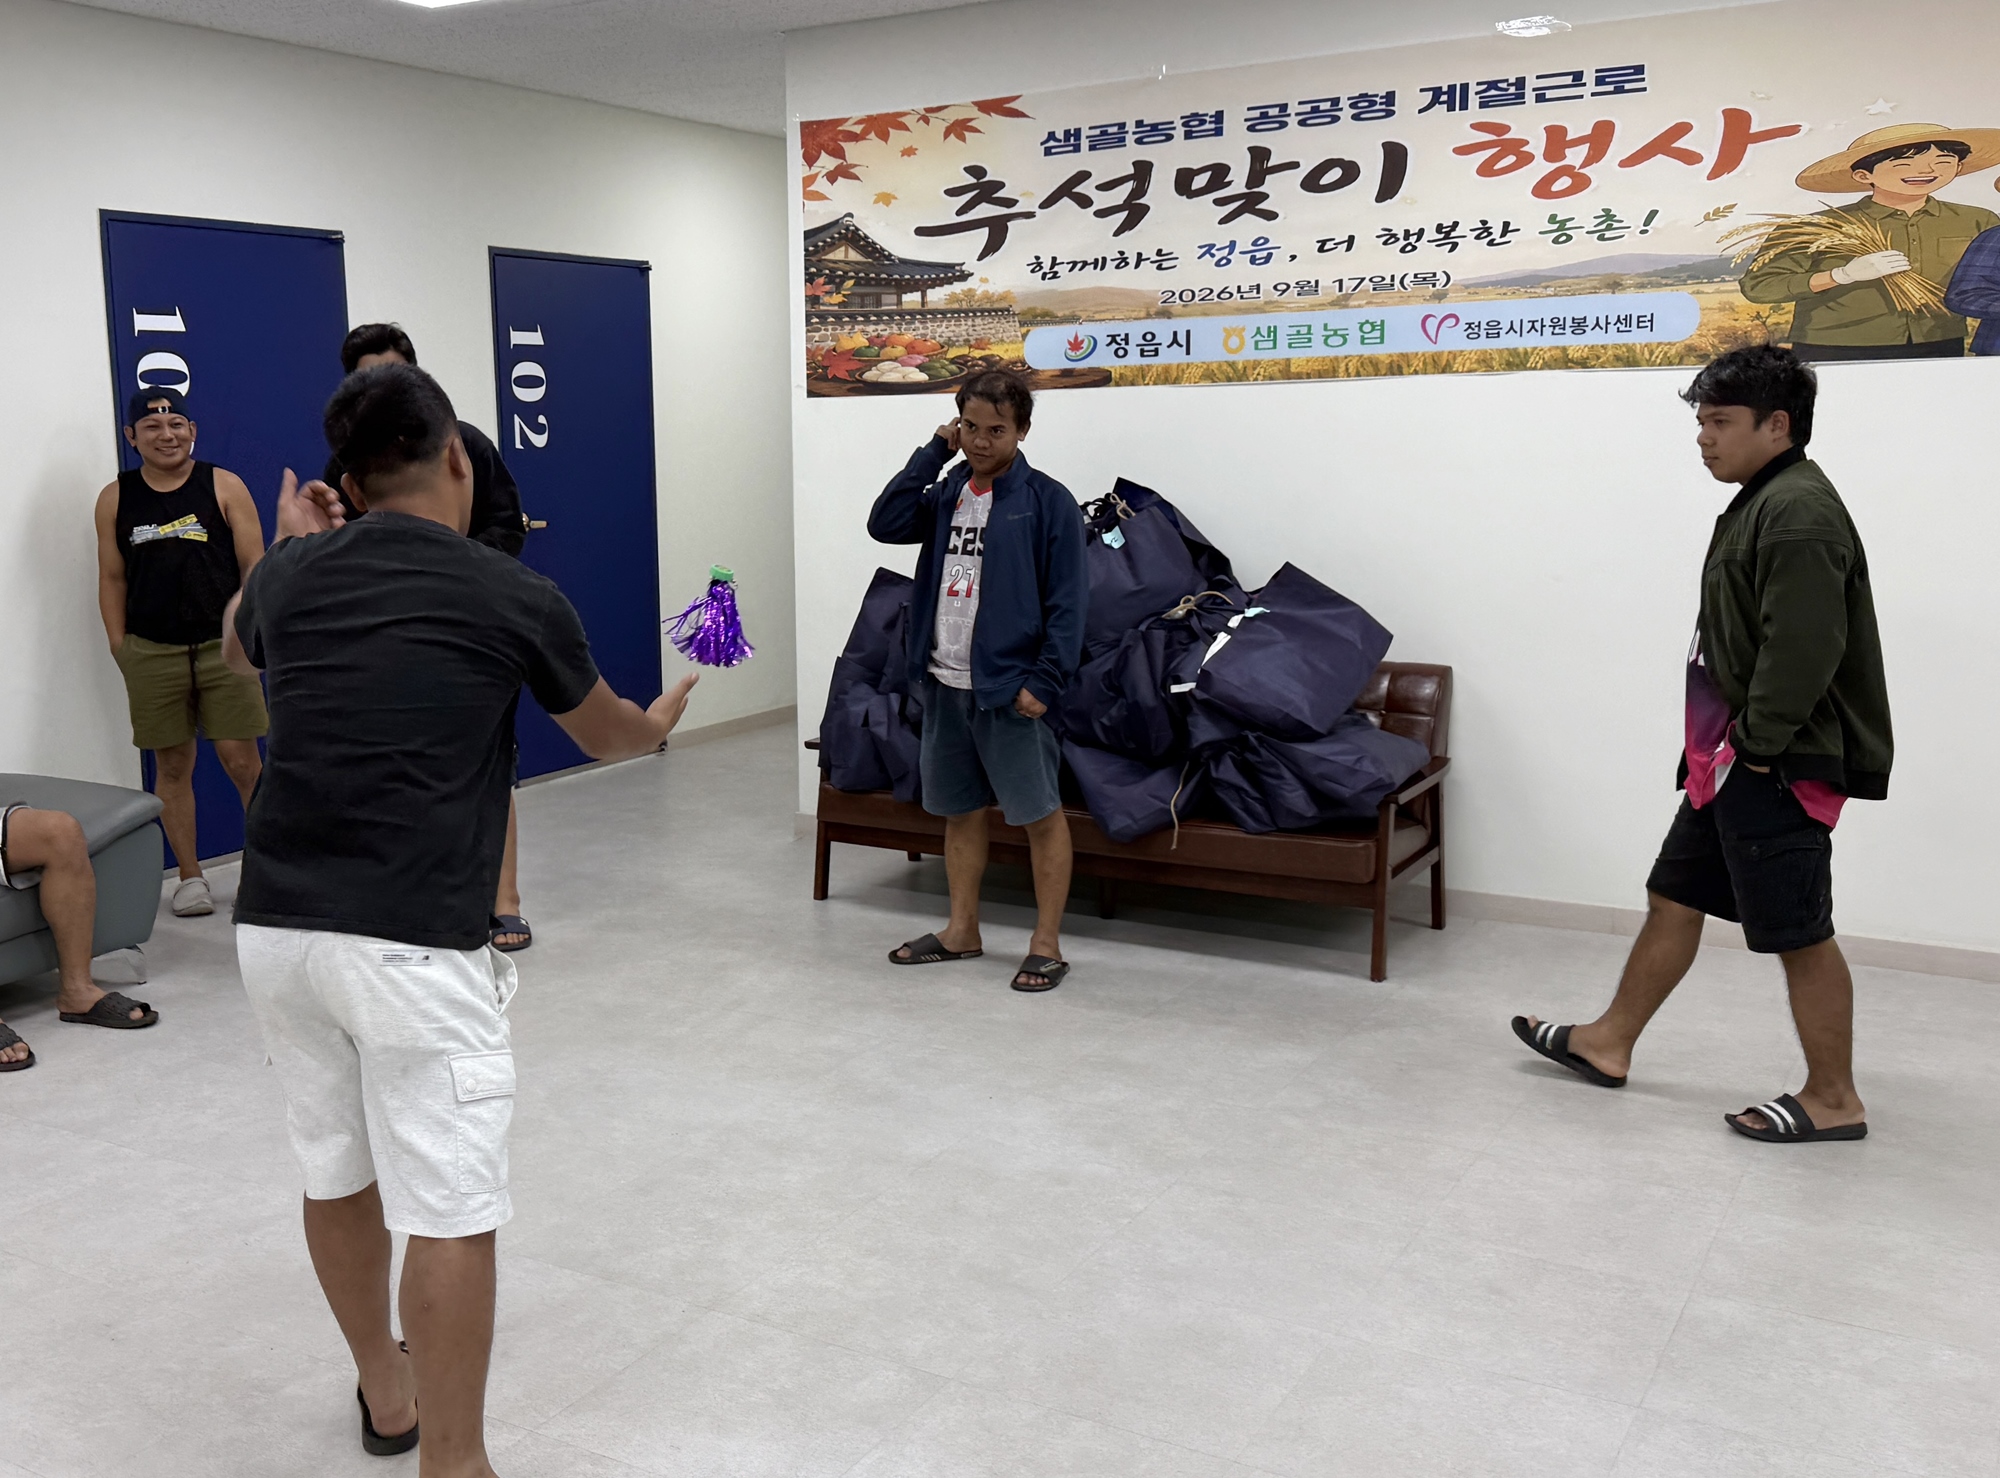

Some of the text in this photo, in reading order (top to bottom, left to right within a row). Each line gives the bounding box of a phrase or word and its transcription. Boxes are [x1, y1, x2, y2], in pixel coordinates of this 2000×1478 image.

[1040, 64, 1648, 157] 샘골농협 공공형 계절근로
[1452, 108, 1803, 200] 행사
[1026, 207, 1659, 281] 함께하는 정읍, 더 행복한 농촌!
[1160, 270, 1451, 304] 2026년 9월 17일(목)
[1251, 319, 1386, 351] 샘골농협
[1463, 312, 1655, 340] 정읍시자원봉사센터
[1105, 329, 1191, 359] 정읍시
[509, 324, 549, 450] 102
[946, 563, 976, 598] 21
